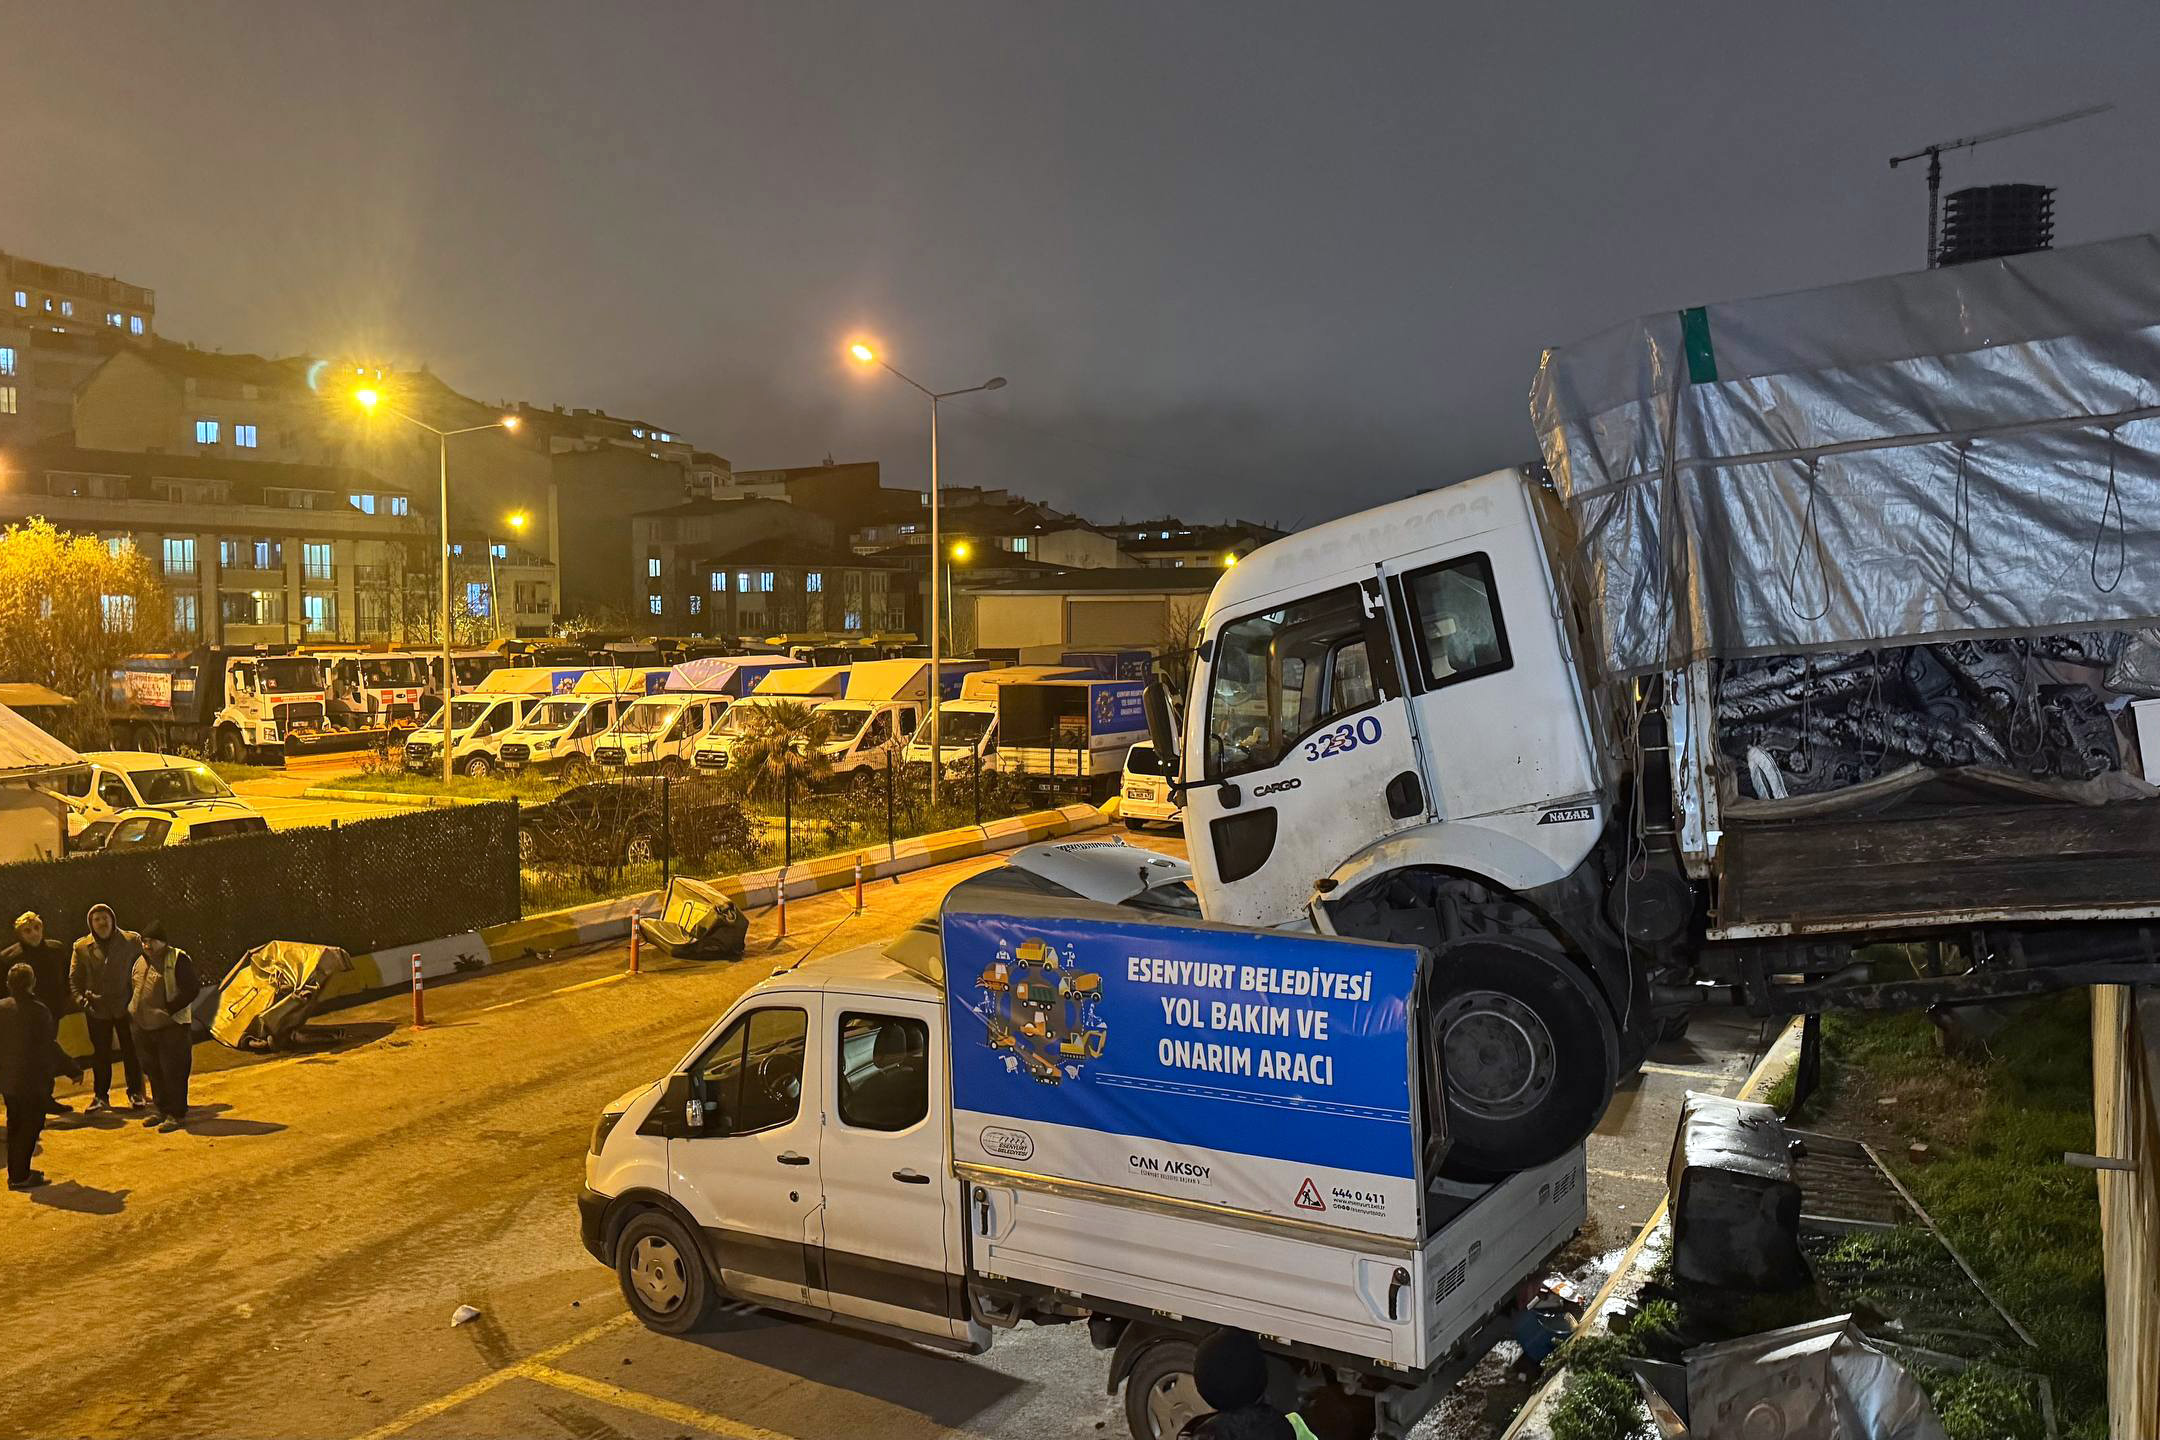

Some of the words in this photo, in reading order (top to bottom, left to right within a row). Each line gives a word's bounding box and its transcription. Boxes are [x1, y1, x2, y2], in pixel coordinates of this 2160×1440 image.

[1253, 778, 1301, 797] CARGO
[1549, 809, 1590, 822] NAZAR
[1127, 957, 1236, 990] ESENYURT
[1240, 966, 1372, 1001] BELEDİYESİ
[1161, 996, 1205, 1029] YOL
[1211, 1001, 1290, 1037] BAKIM
[1297, 1009, 1328, 1041] VE
[1158, 1038, 1251, 1076] ONARIM
[1258, 1050, 1333, 1085] ARACI
[1129, 1155, 1159, 1171] CAN
[1164, 1160, 1210, 1179] AKSOY
[1332, 1187, 1352, 1199] 444
[1355, 1191, 1363, 1201] 0
[1365, 1192, 1385, 1204] 411
